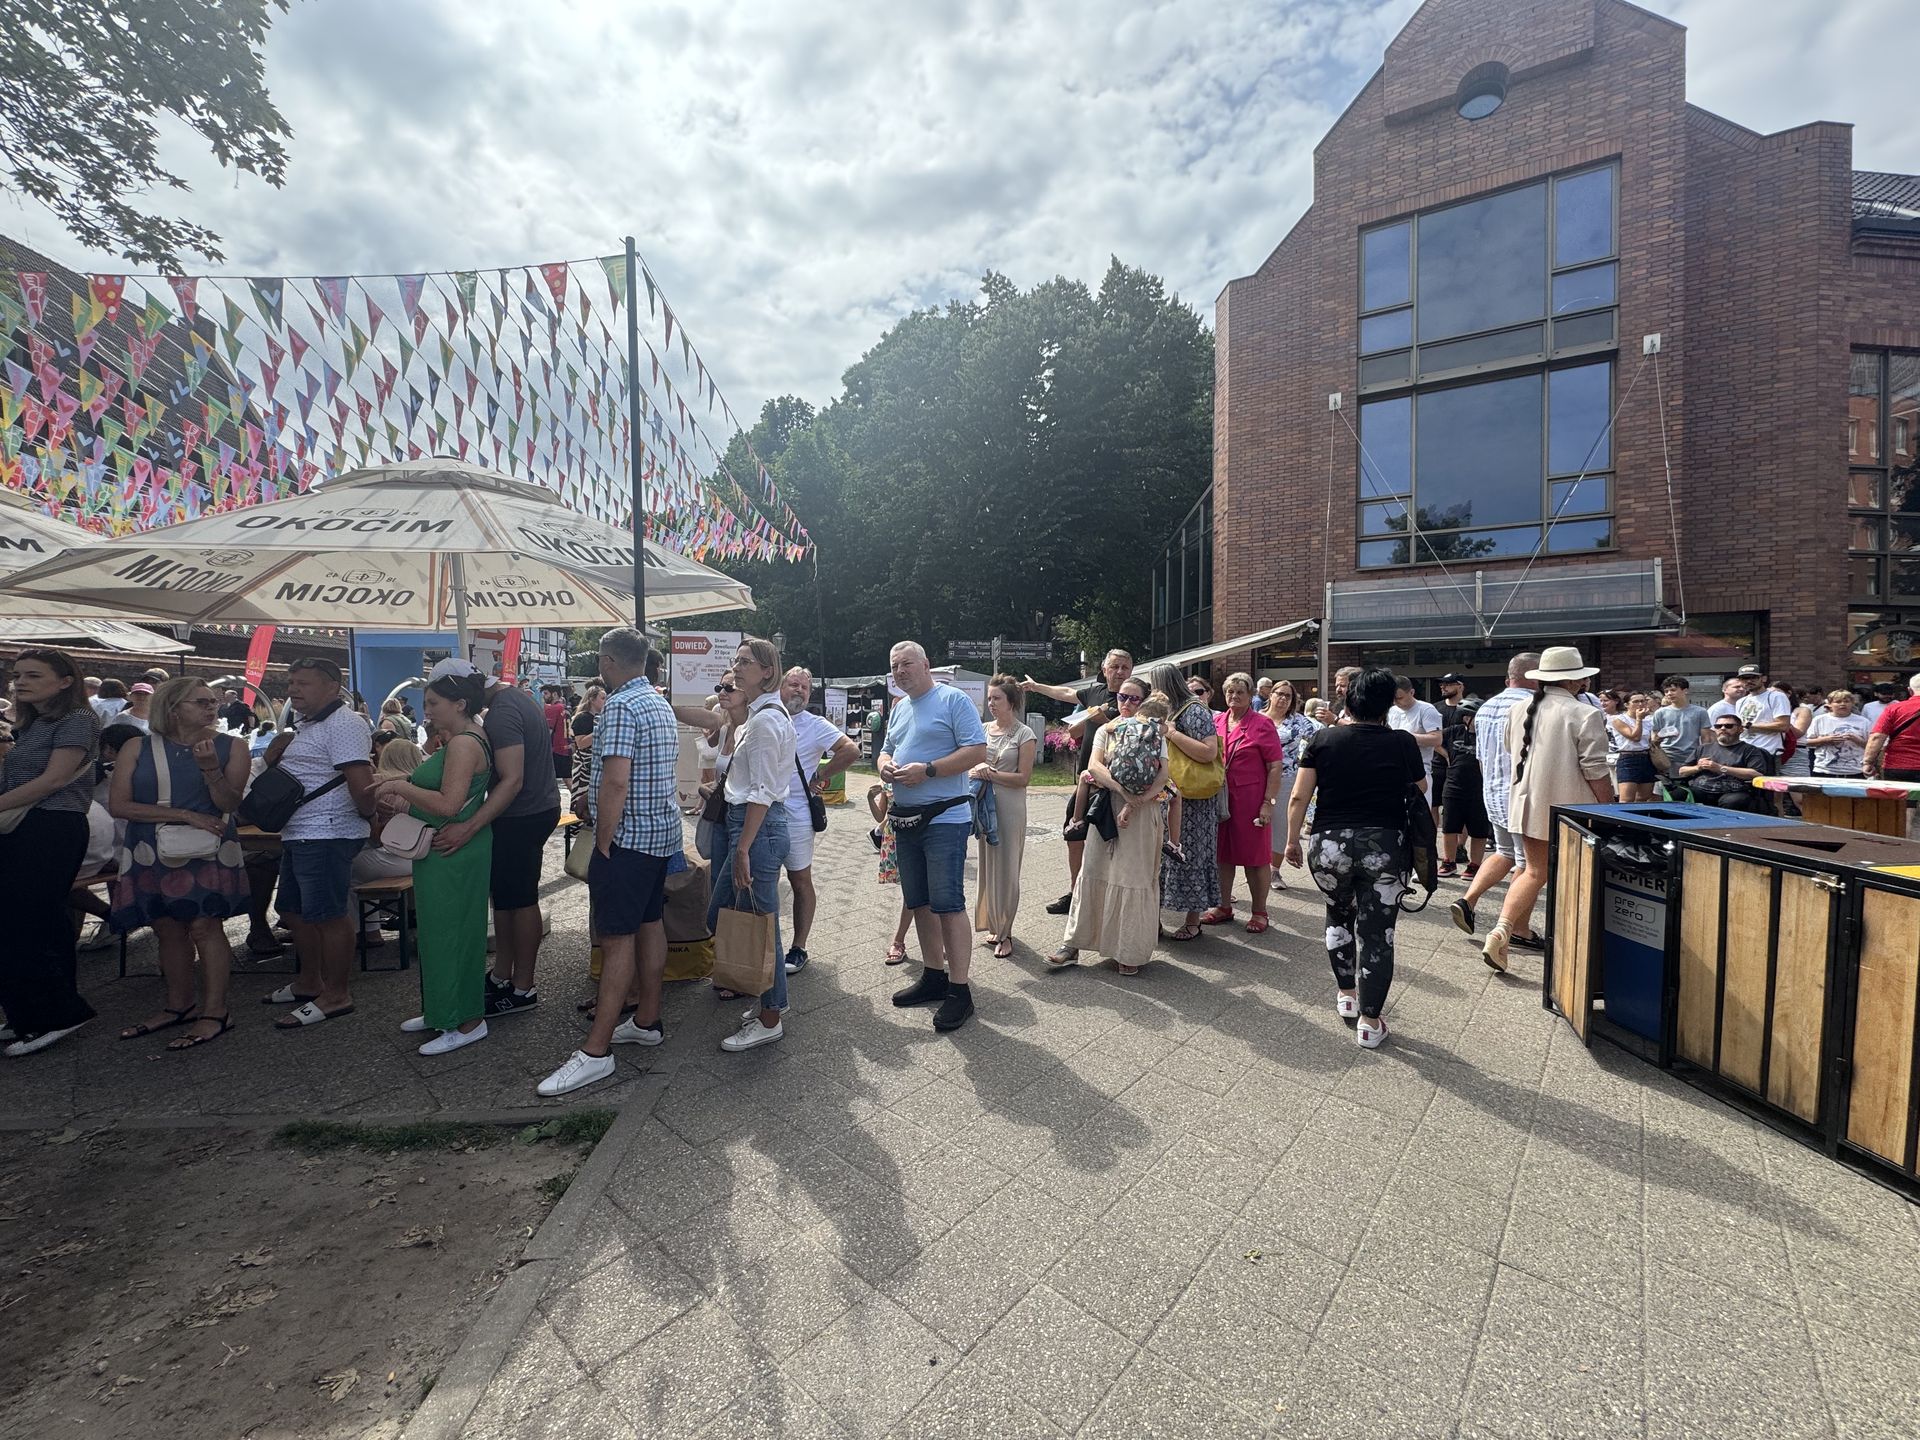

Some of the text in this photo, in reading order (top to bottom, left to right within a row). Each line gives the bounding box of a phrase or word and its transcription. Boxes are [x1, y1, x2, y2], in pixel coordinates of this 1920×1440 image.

[235, 515, 454, 533] OKOCIM
[674, 639, 708, 650] ODWIEDŹ
[1611, 870, 1666, 893] PAPIER
[1614, 896, 1635, 909] pre
[1614, 905, 1644, 921] zero
